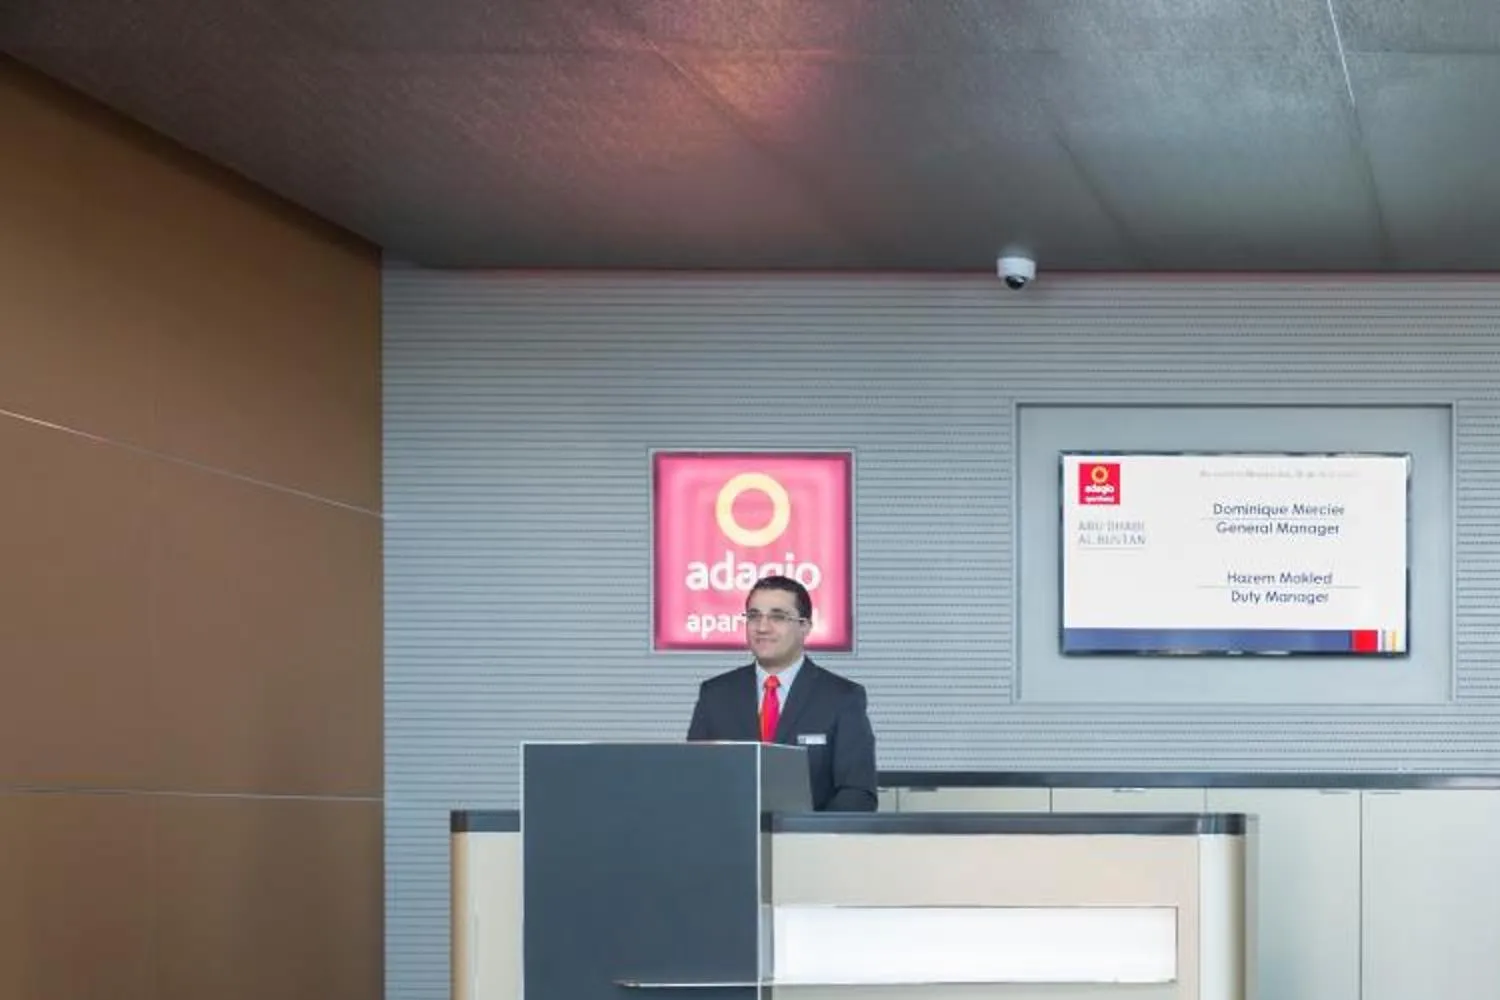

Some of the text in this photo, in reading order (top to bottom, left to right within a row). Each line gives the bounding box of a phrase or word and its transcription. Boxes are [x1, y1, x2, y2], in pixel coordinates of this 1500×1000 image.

[1213, 503, 1345, 517] Dominique Mercier
[1216, 521, 1340, 536] General Manager
[1227, 571, 1333, 584] Hazem Mokled
[1231, 590, 1330, 604] Duty Manager
